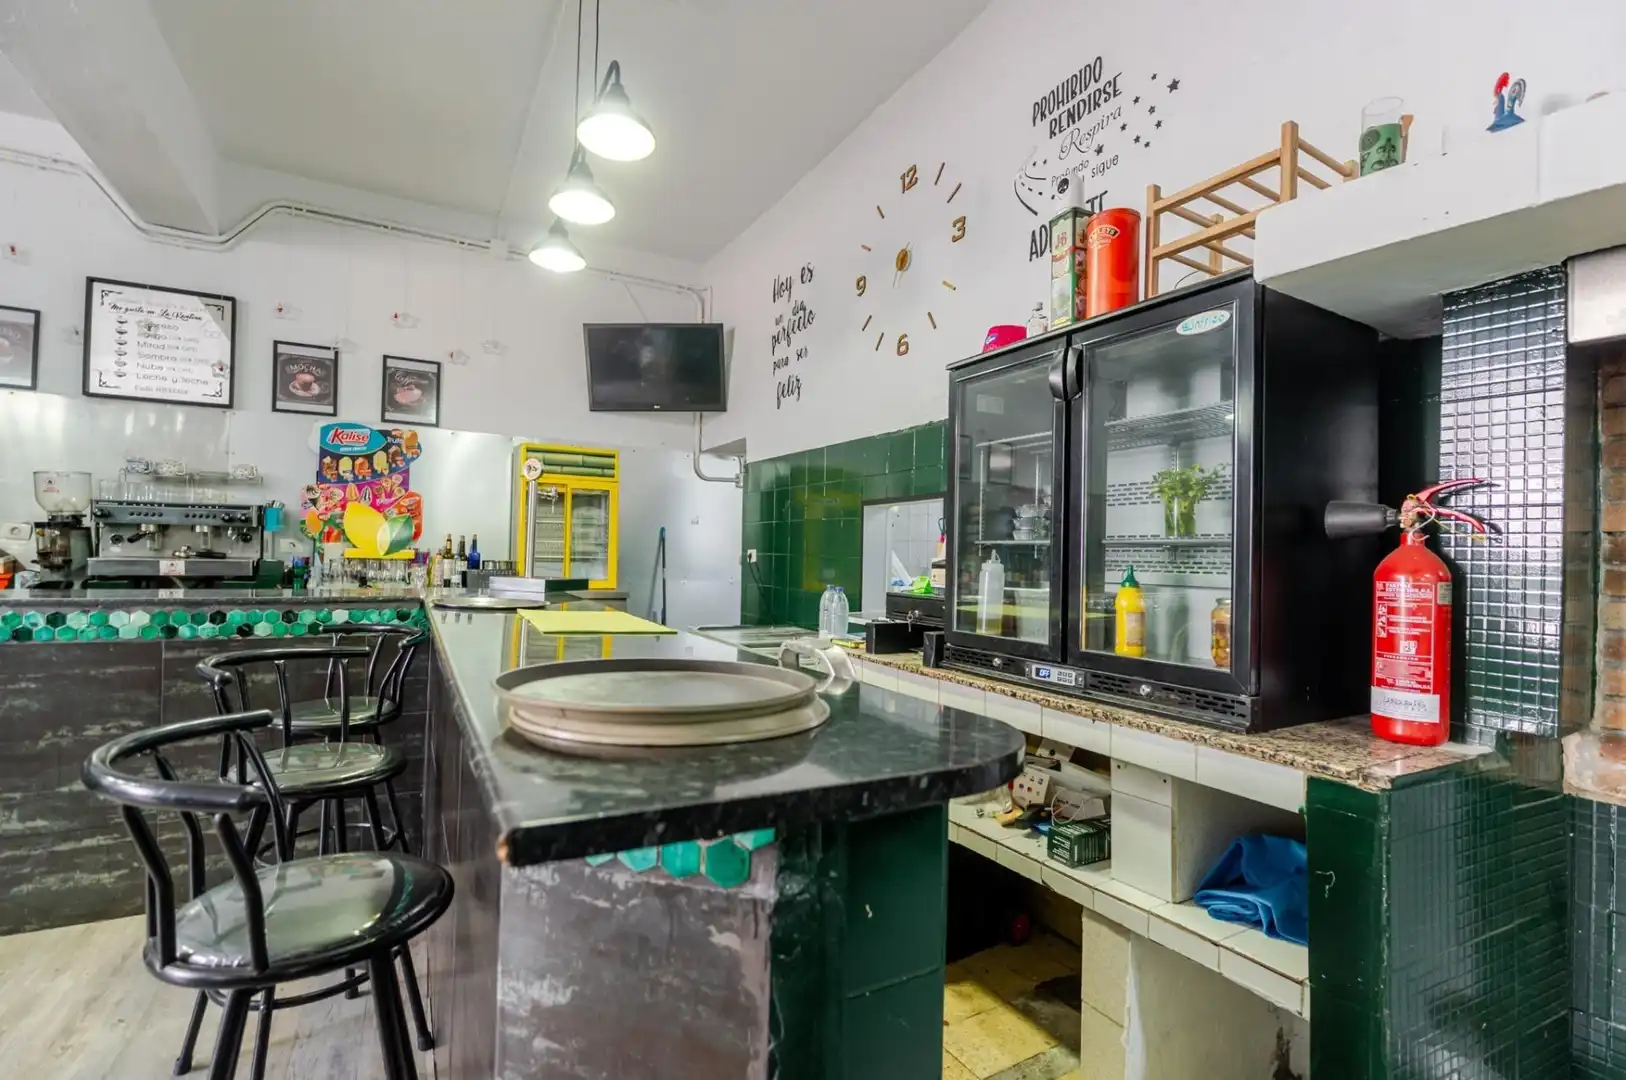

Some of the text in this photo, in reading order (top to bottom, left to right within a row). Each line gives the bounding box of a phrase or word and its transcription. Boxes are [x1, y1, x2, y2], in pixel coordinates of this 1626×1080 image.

[1032, 55, 1103, 128] PROHIBIDO
[1049, 71, 1123, 139] RENDIRSE
[1058, 105, 1122, 160] Respira
[900, 164, 918, 194] 12
[1091, 154, 1119, 179] sigue
[952, 215, 966, 243] 3
[772, 261, 815, 303] Hoy es
[856, 275, 867, 297] 9
[771, 309, 816, 356] perfecto
[896, 333, 909, 356] 6
[137, 362, 164, 372] Nube
[773, 346, 808, 377] para ser
[776, 373, 802, 410] feliz
[330, 428, 370, 445] Kalise
